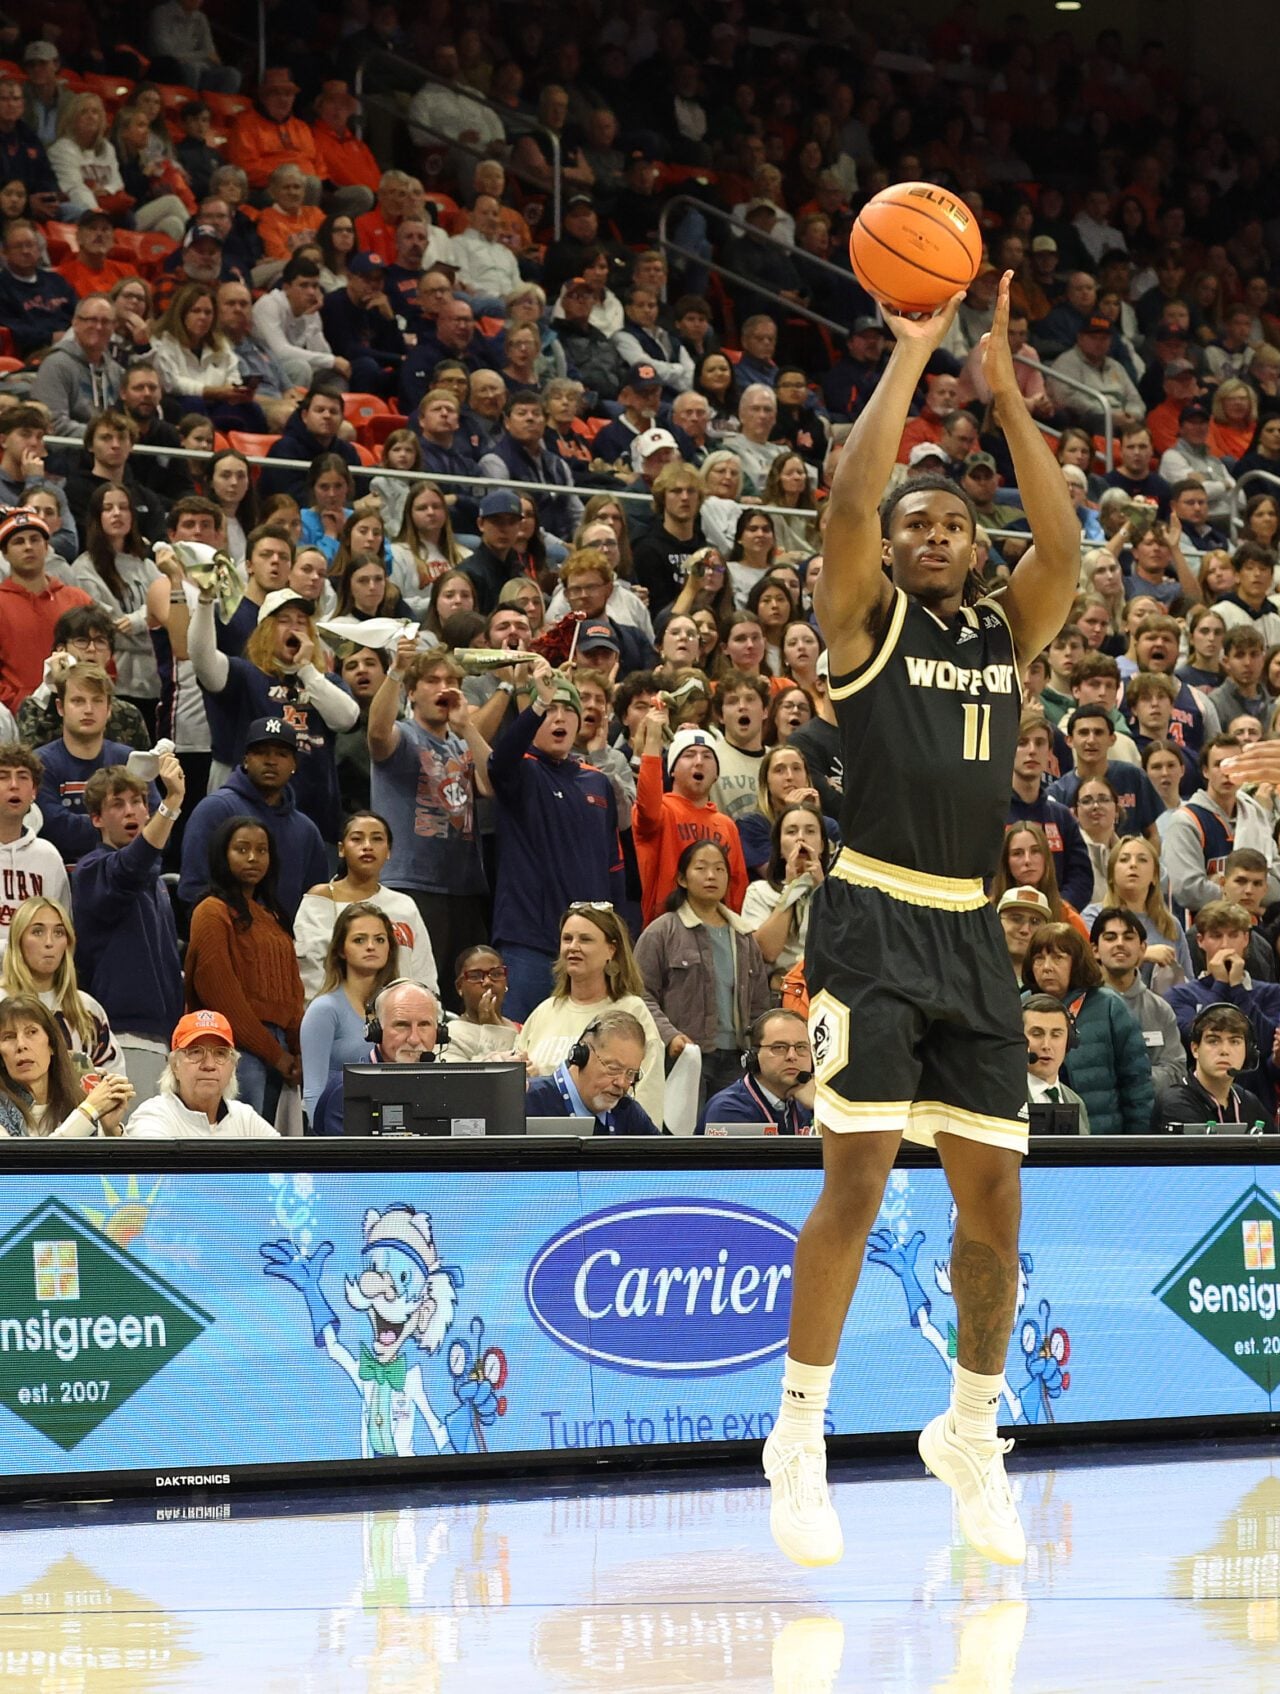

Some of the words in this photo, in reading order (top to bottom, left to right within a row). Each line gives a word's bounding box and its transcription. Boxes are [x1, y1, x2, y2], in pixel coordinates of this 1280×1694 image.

[961, 703, 991, 761] 11
[573, 1248, 792, 1320] Carrier
[1234, 1339, 1260, 1356] est.
[18, 1383, 54, 1405] est.
[60, 1381, 111, 1403] 2007
[541, 1410, 616, 1450] Turn
[625, 1410, 656, 1444] to
[665, 1406, 714, 1444] the
[156, 1474, 231, 1487] DAKTRONICS
